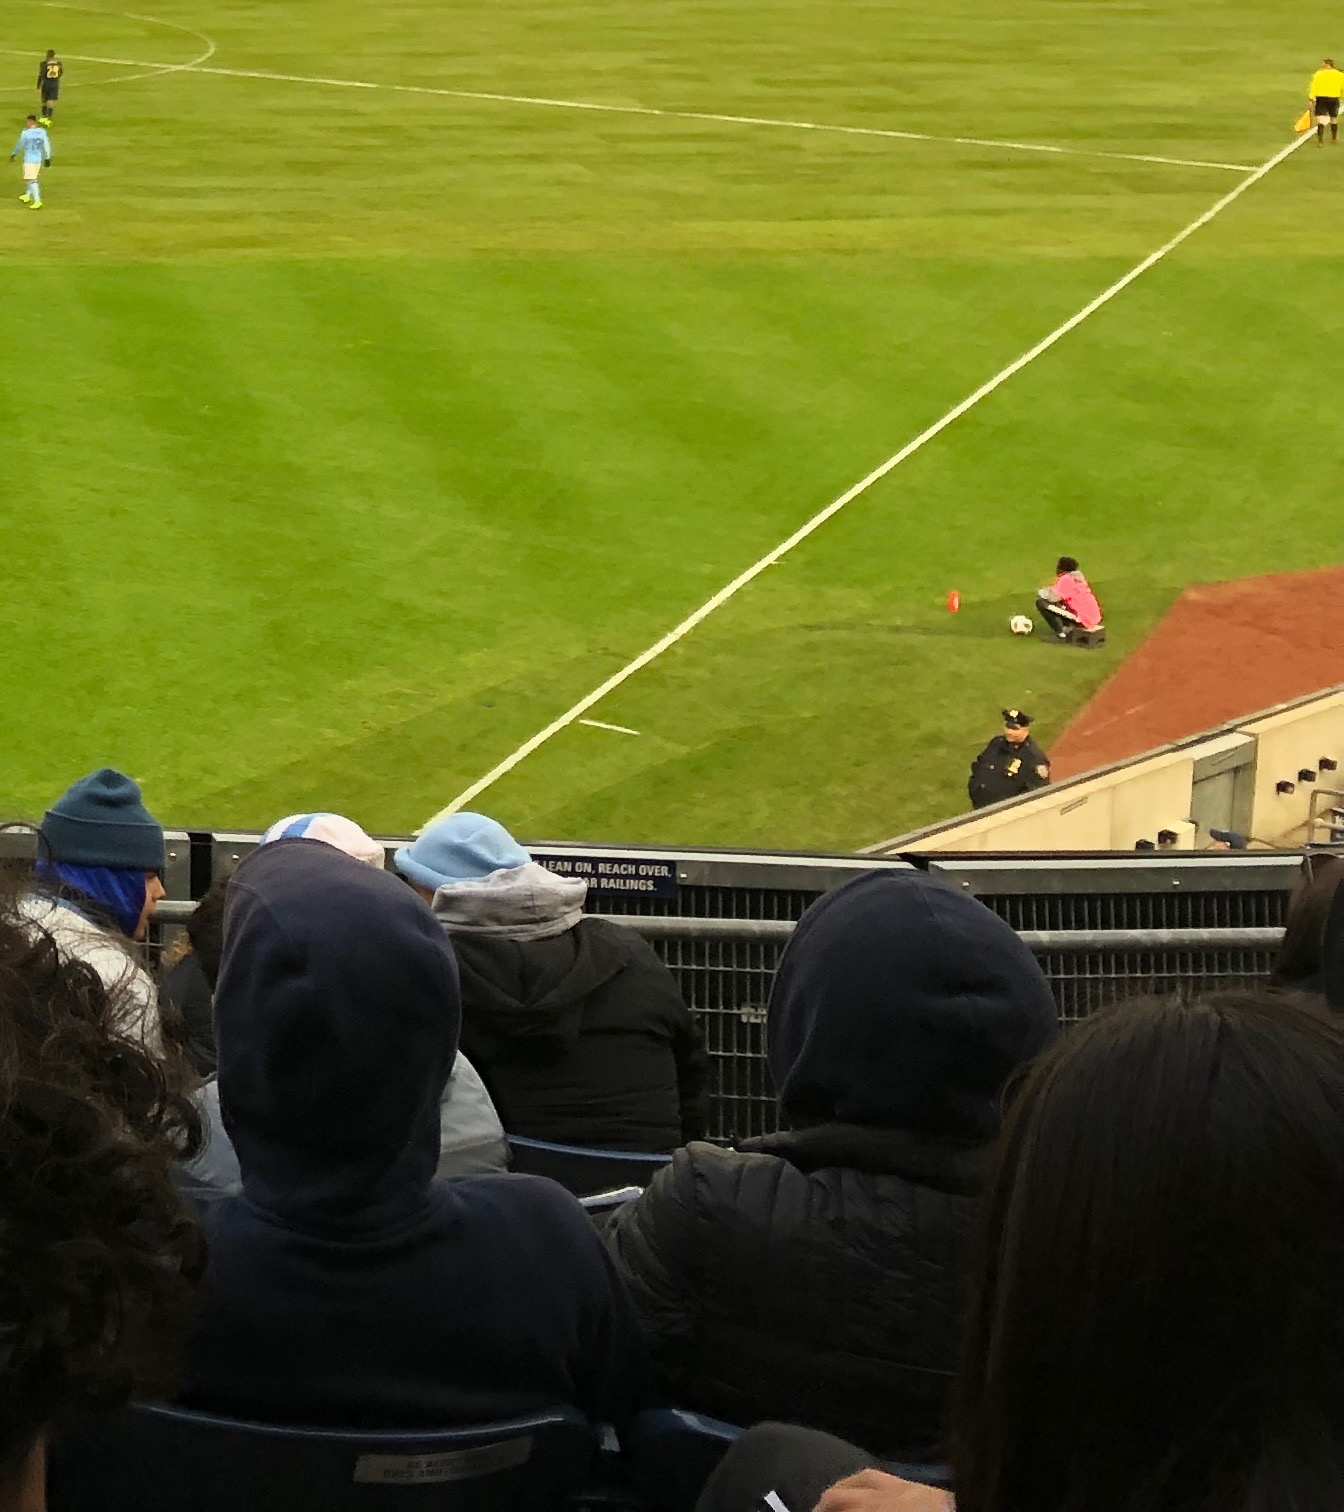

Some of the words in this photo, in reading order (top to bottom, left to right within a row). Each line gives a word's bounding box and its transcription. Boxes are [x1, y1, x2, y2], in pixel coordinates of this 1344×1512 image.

[575, 862, 596, 875] ON,
[597, 863, 637, 876] REACH
[638, 865, 672, 879] OVER,
[600, 878, 657, 892] RAILINGS.
